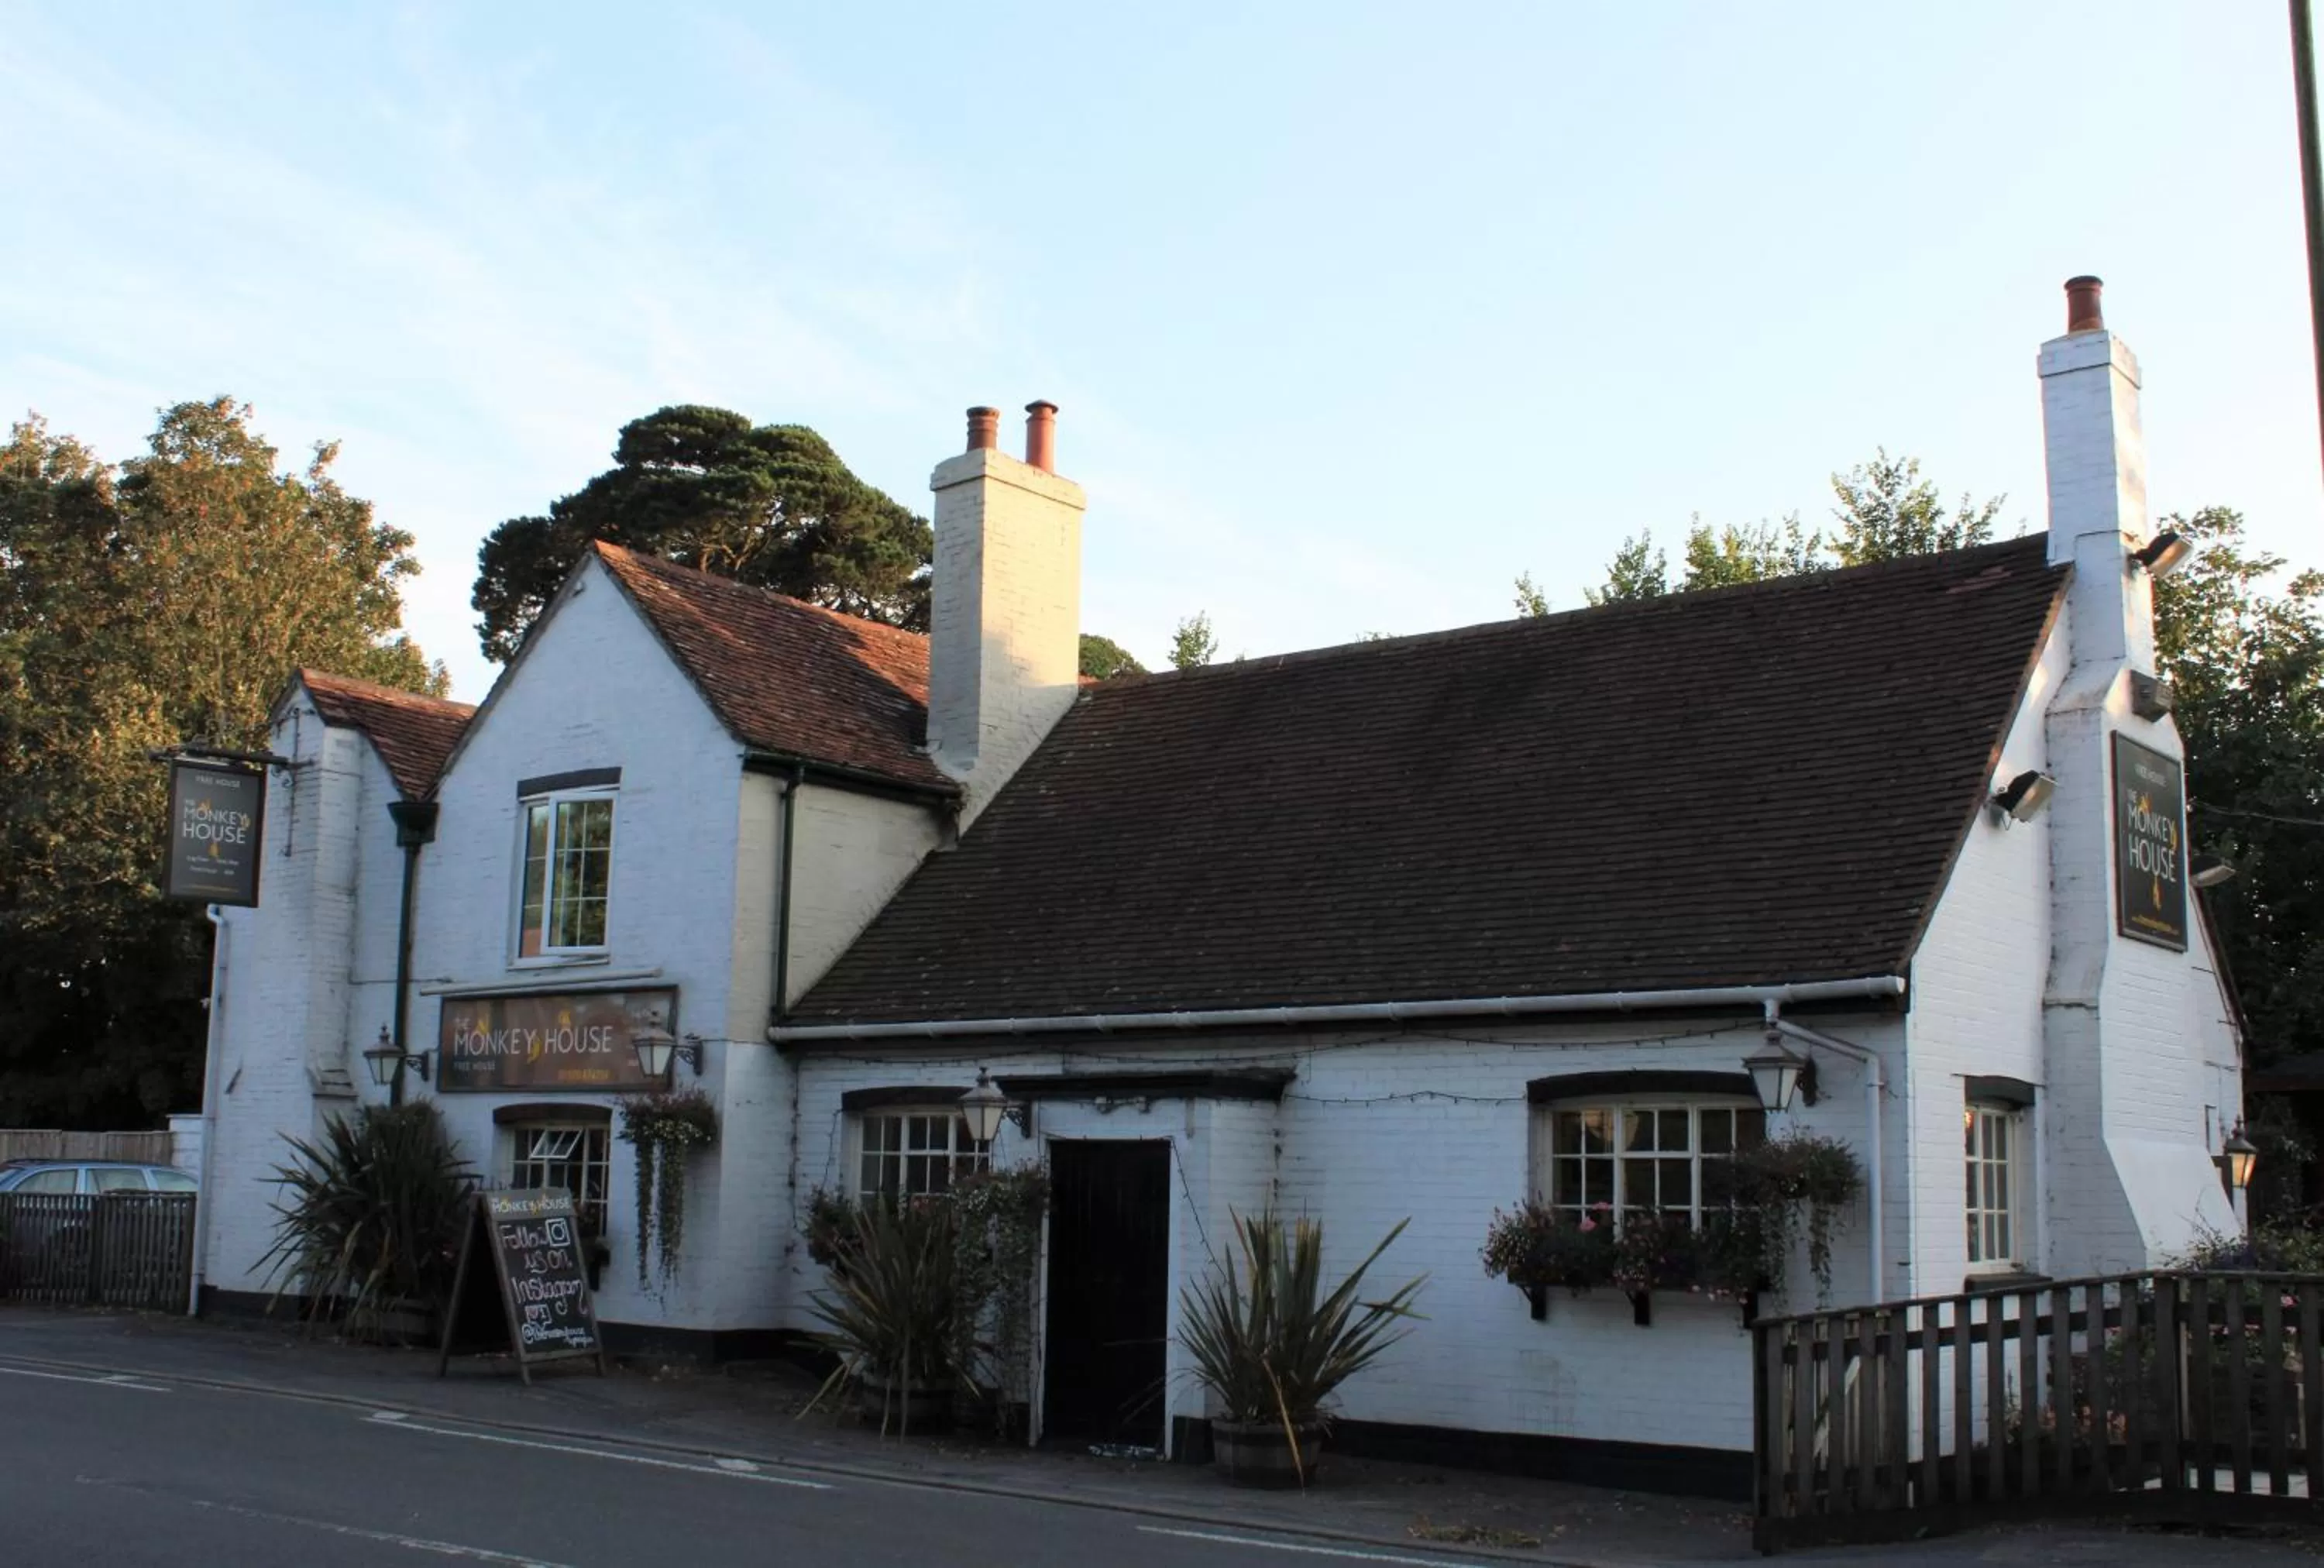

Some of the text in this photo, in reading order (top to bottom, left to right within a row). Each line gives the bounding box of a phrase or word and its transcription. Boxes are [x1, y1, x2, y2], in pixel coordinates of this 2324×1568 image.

[182, 821, 246, 844] HOUSE
[183, 806, 247, 827] MONKEY
[2127, 803, 2175, 843] MONKEY
[2128, 833, 2177, 883] HOUSE
[454, 1025, 614, 1057] MONKEY HOUSE
